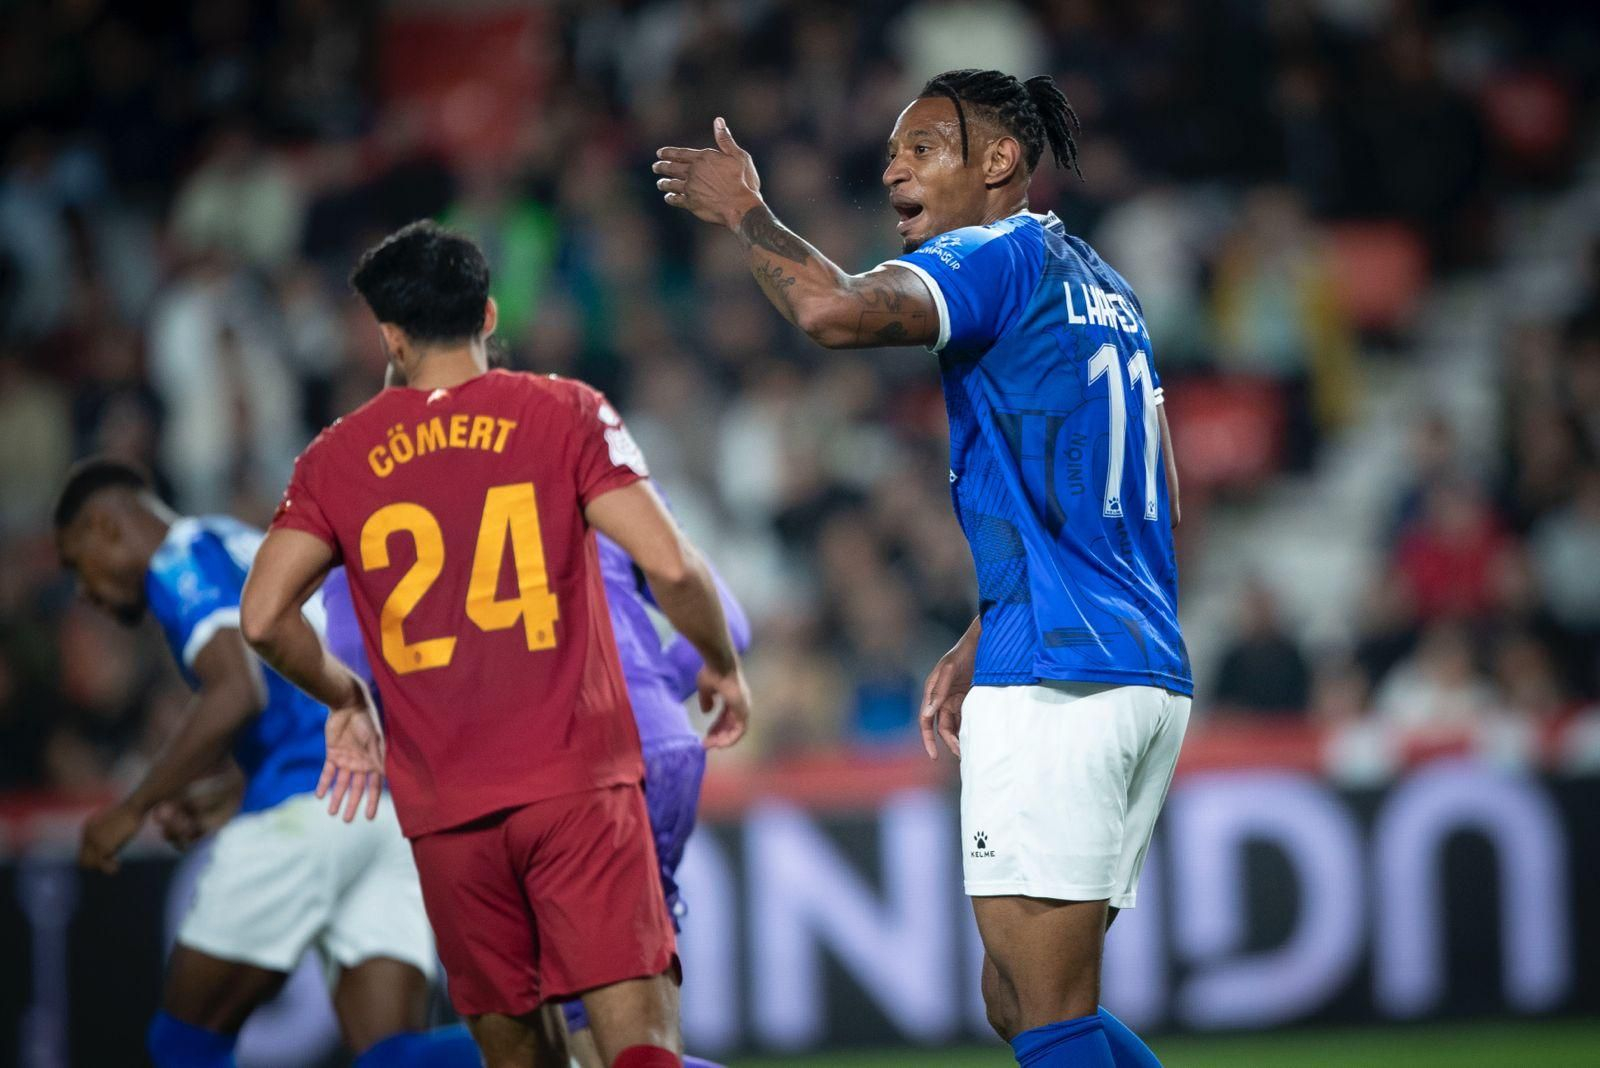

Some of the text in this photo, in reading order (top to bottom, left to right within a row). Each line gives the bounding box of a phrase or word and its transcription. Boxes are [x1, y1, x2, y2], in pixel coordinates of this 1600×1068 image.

[367, 413, 517, 478] CÖMERT
[1087, 343, 1159, 520] 11
[1063, 433, 1088, 496] UNIÓN
[359, 482, 560, 675] 24
[970, 850, 996, 858] KELME
